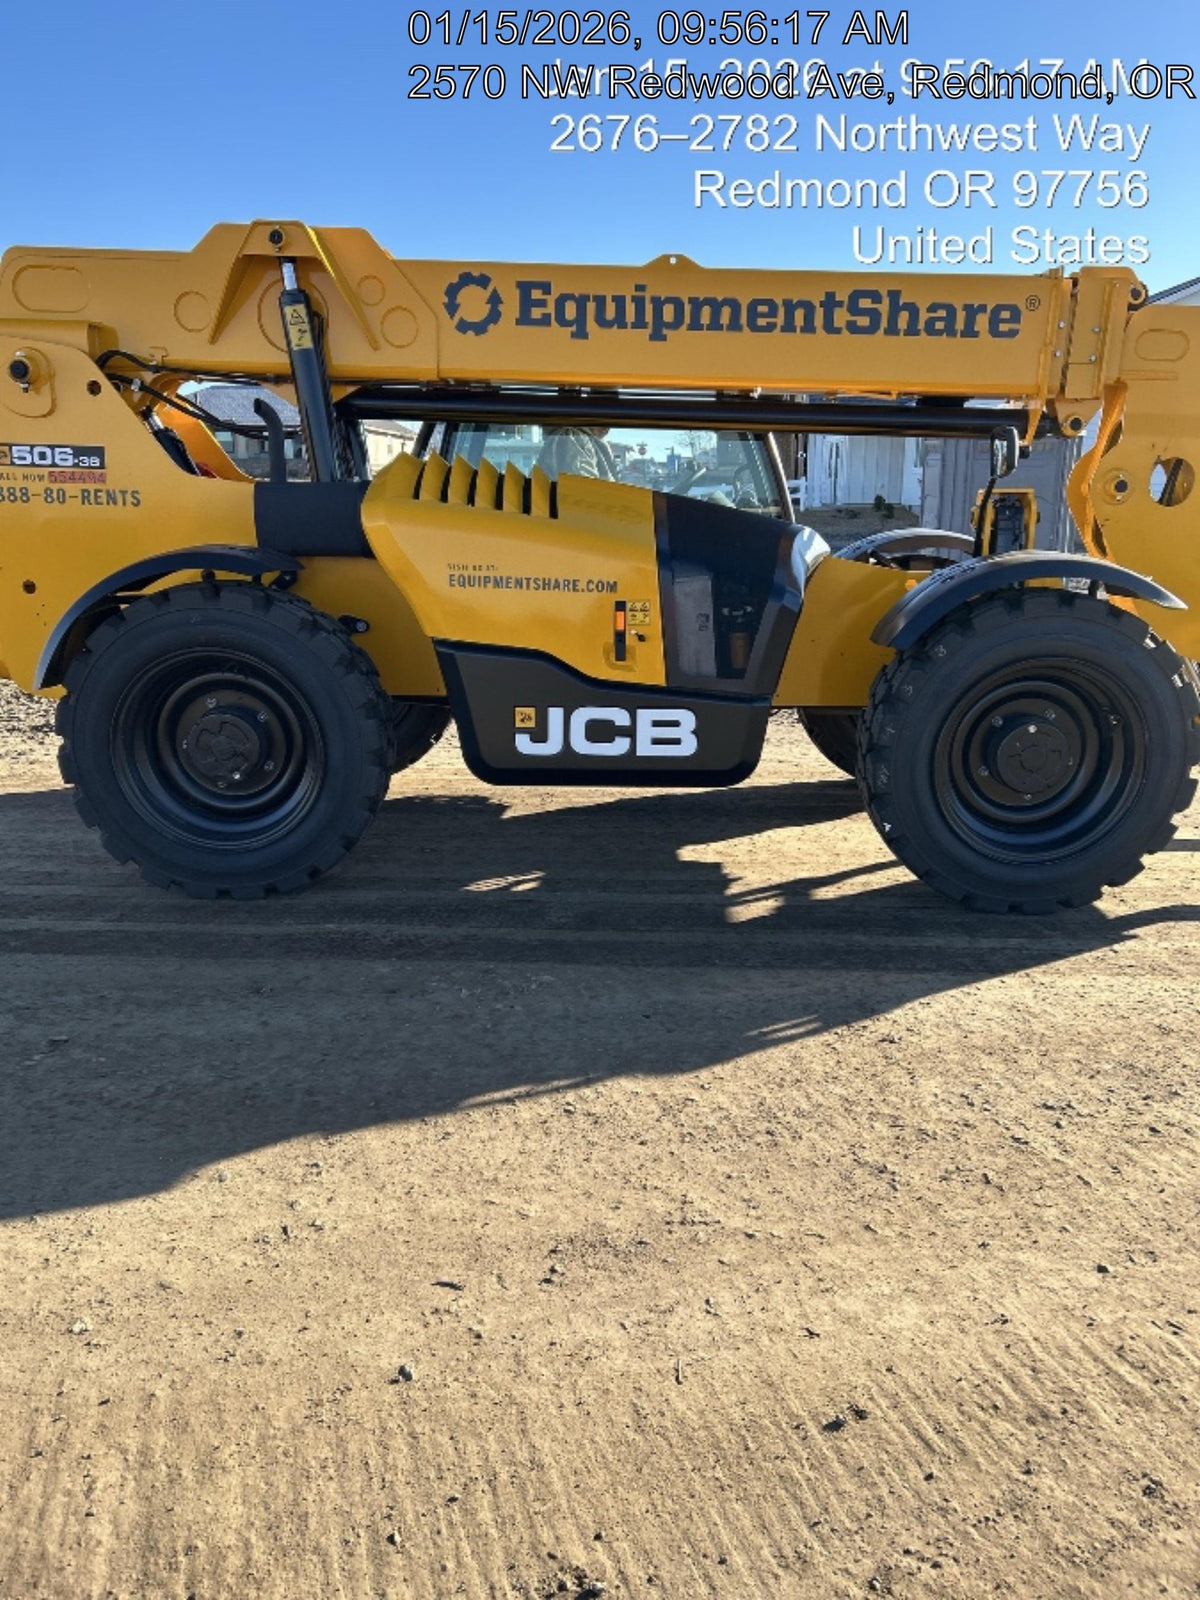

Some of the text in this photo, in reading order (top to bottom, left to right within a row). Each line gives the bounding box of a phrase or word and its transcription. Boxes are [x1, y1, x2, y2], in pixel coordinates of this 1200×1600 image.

[514, 280, 1022, 343] EquipmentShare
[449, 573, 618, 594] EQUIPMENTSHARE.COM
[515, 706, 698, 757] JCB
